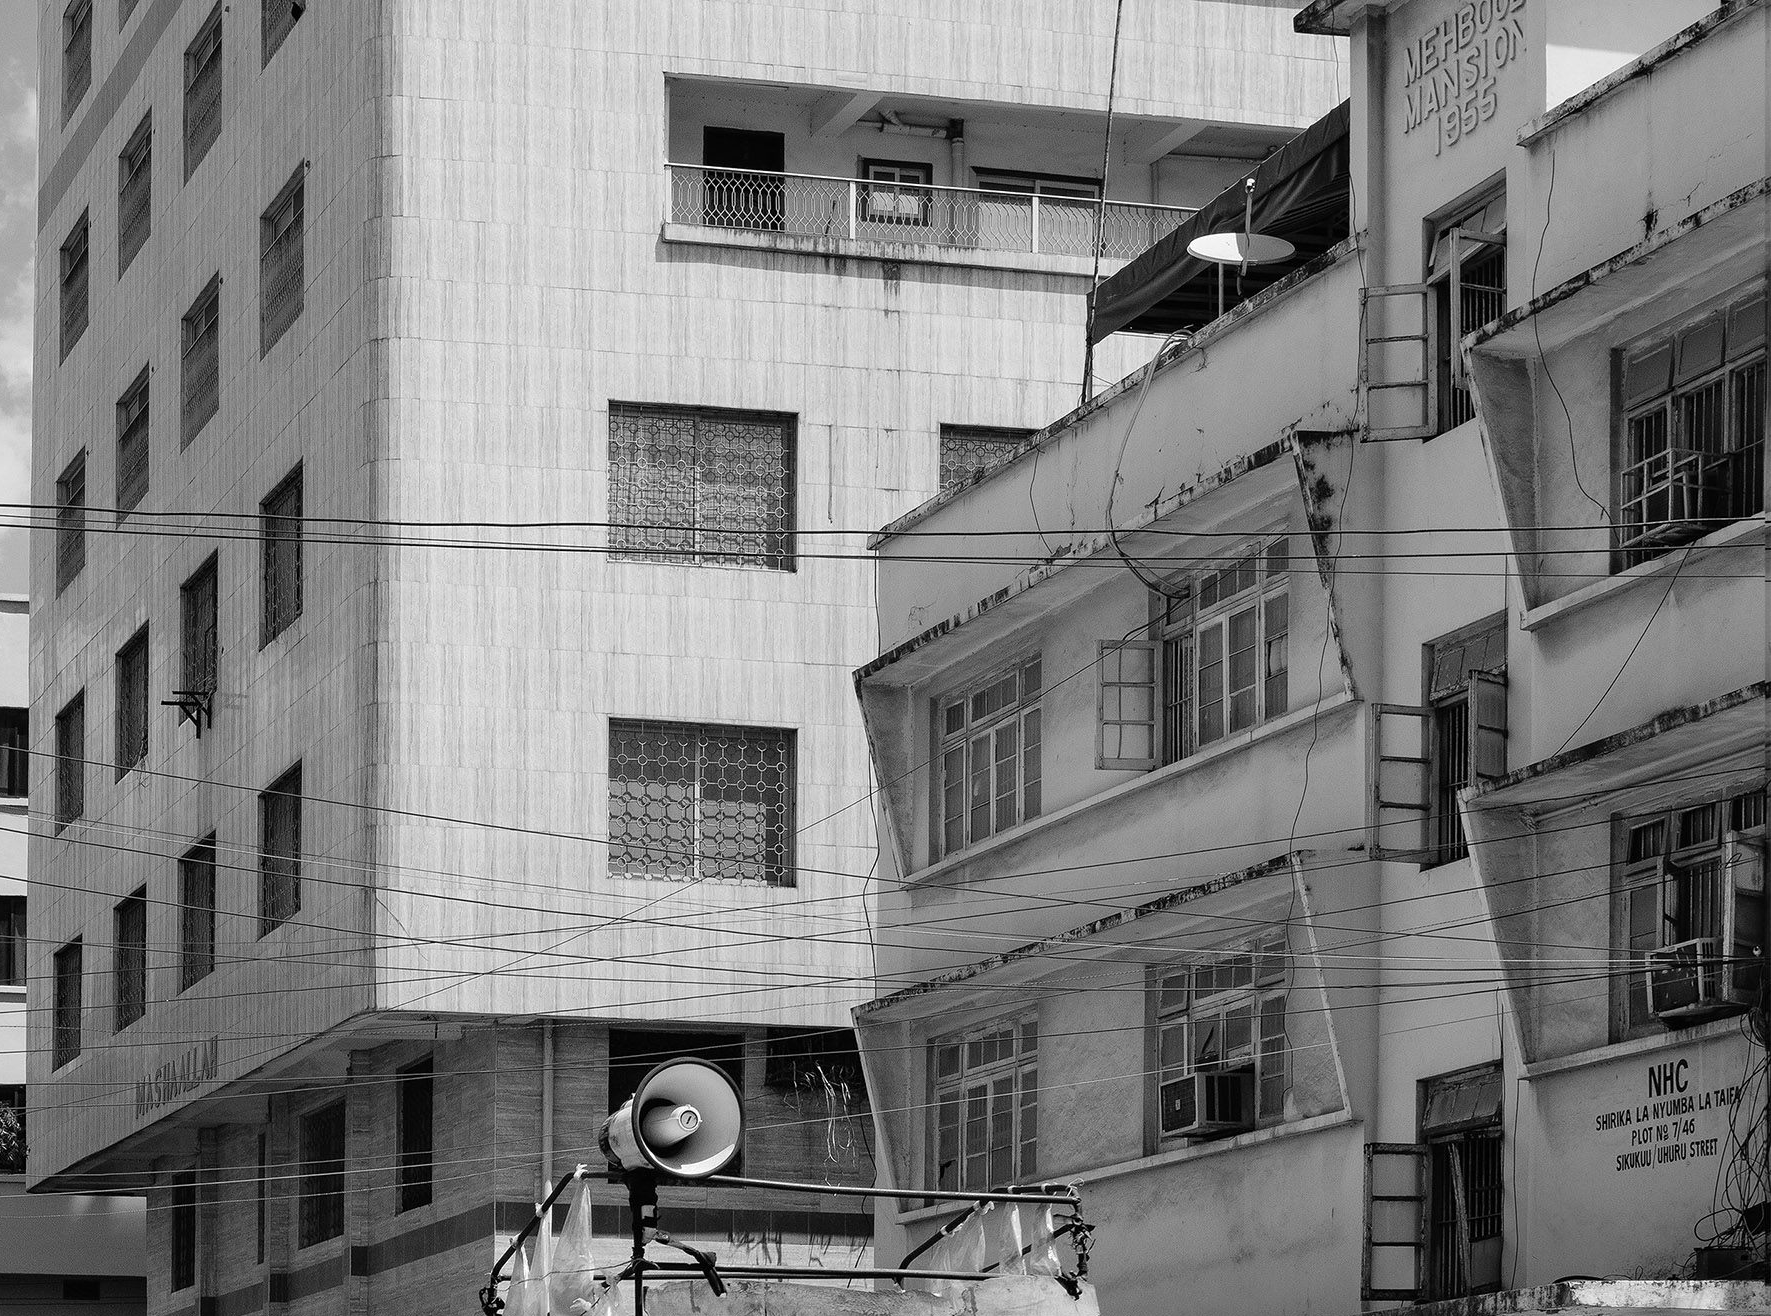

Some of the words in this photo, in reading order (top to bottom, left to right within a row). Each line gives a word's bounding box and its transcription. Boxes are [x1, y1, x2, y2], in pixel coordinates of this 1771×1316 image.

[1405, 18, 1524, 134] MANSION
[1435, 77, 1497, 157] 1955
[1648, 1058, 1689, 1098] NHC
[1595, 1108, 1632, 1131] SHIRIKA
[1636, 1106, 1649, 1123] LA
[1653, 1095, 1694, 1120] NYUMBA
[1698, 1092, 1712, 1111] LA
[1714, 1086, 1741, 1108] TAIFA
[1631, 1126, 1653, 1146] PLOT
[1672, 1118, 1695, 1142] 7/46
[1690, 1138, 1718, 1158] STREET
